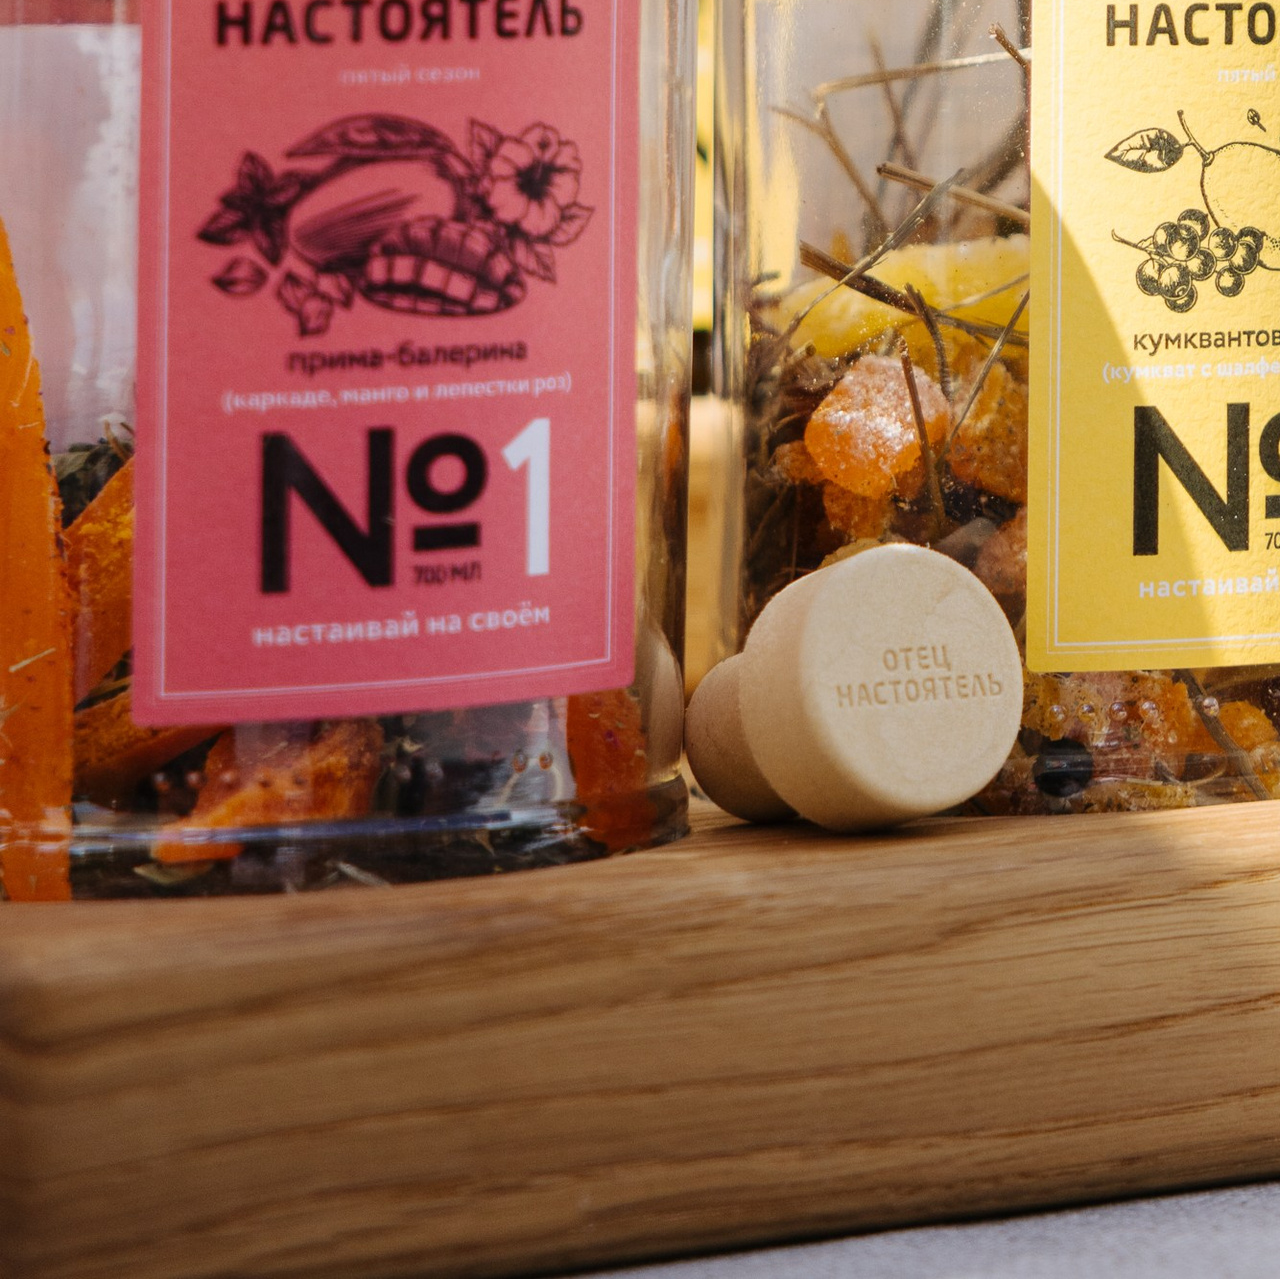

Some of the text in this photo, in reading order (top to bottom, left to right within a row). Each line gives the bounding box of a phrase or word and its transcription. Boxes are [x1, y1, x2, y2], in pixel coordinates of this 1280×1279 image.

[340, 63, 480, 84] пятый сезон
[1218, 63, 1276, 82] пятый
[286, 339, 528, 378] прима-балерина
[1102, 361, 1197, 384] (кумкват
[1201, 362, 1213, 378] с
[223, 371, 573, 415] (каркаде, манго и лепестки роз)
[414, 563, 446, 585] 700
[1139, 568, 1280, 598] настаивай
[253, 600, 550, 646] настаивай на своём
[882, 643, 952, 672] ОТЕЦ
[836, 672, 1004, 709] НАСТОЯТЕЛЬ
